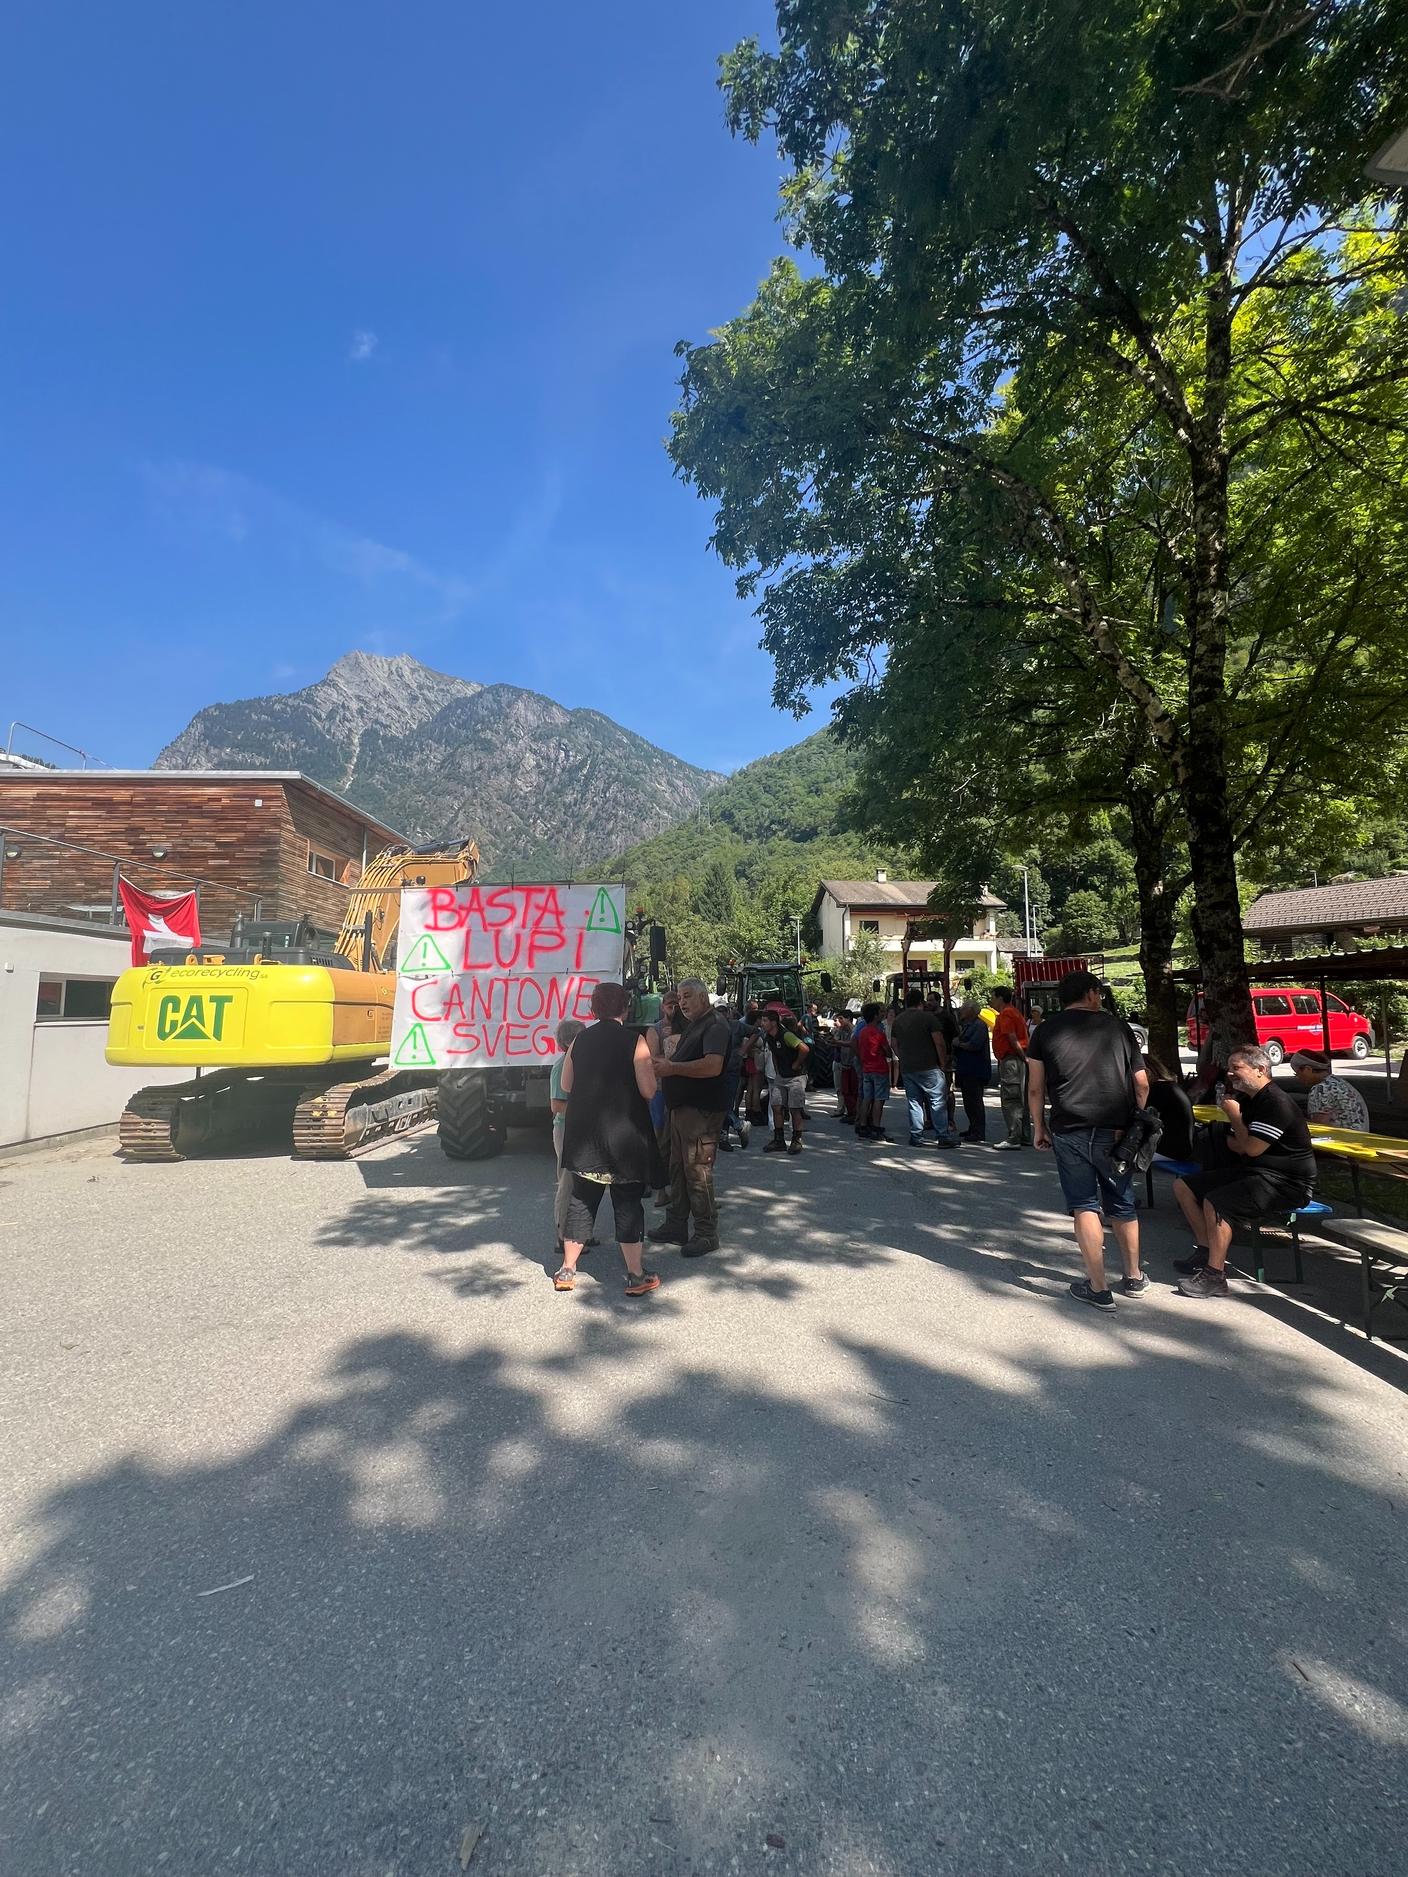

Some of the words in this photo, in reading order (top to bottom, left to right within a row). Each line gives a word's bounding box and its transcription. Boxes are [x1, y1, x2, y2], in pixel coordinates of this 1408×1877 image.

[424, 886, 565, 932] BASTA
[170, 967, 260, 981] ecorecycling
[157, 995, 233, 1042] CAT
[412, 976, 600, 1021] CANTONE
[446, 1022, 567, 1057] SVEG
